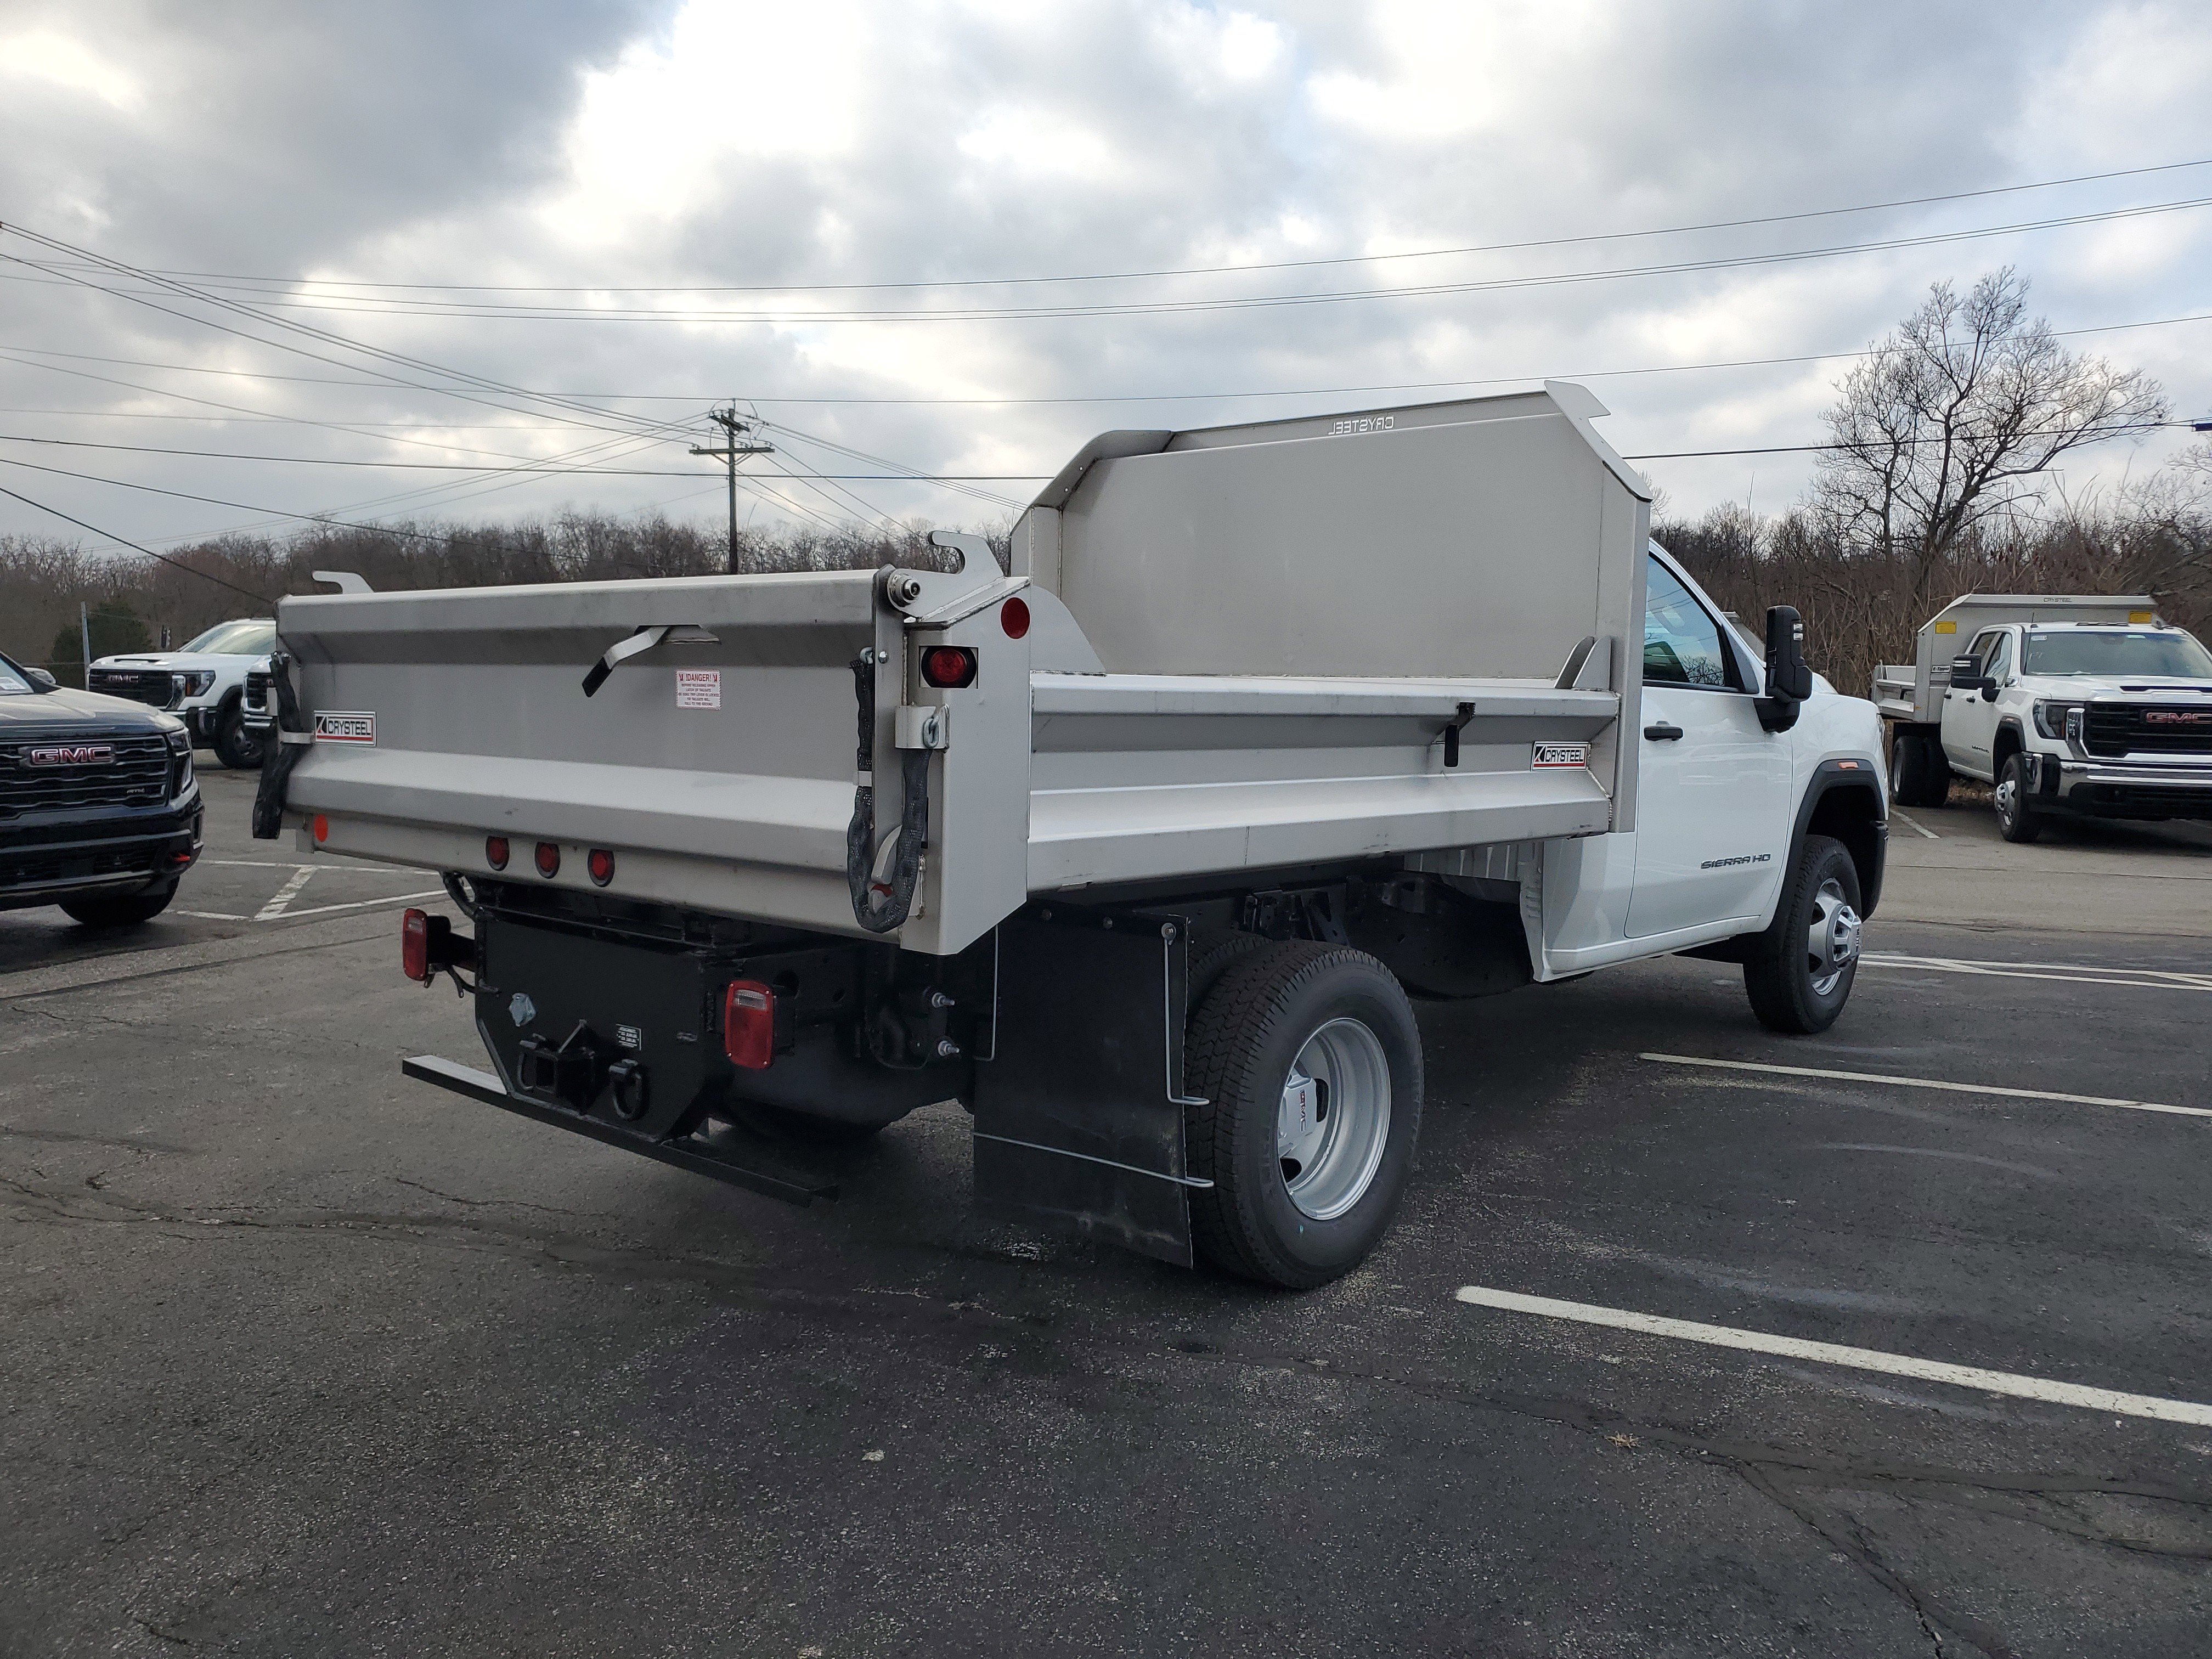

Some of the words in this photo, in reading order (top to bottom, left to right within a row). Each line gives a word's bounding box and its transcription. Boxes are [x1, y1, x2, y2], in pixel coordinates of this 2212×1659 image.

[2146, 713, 2212, 724] GMC
[329, 720, 371, 735] CRYSTEEL
[31, 746, 112, 764] GMC
[1545, 749, 1583, 763] CRYSTEEL
[1701, 856, 1751, 869] SIERRA
[1752, 854, 1771, 863] HD
